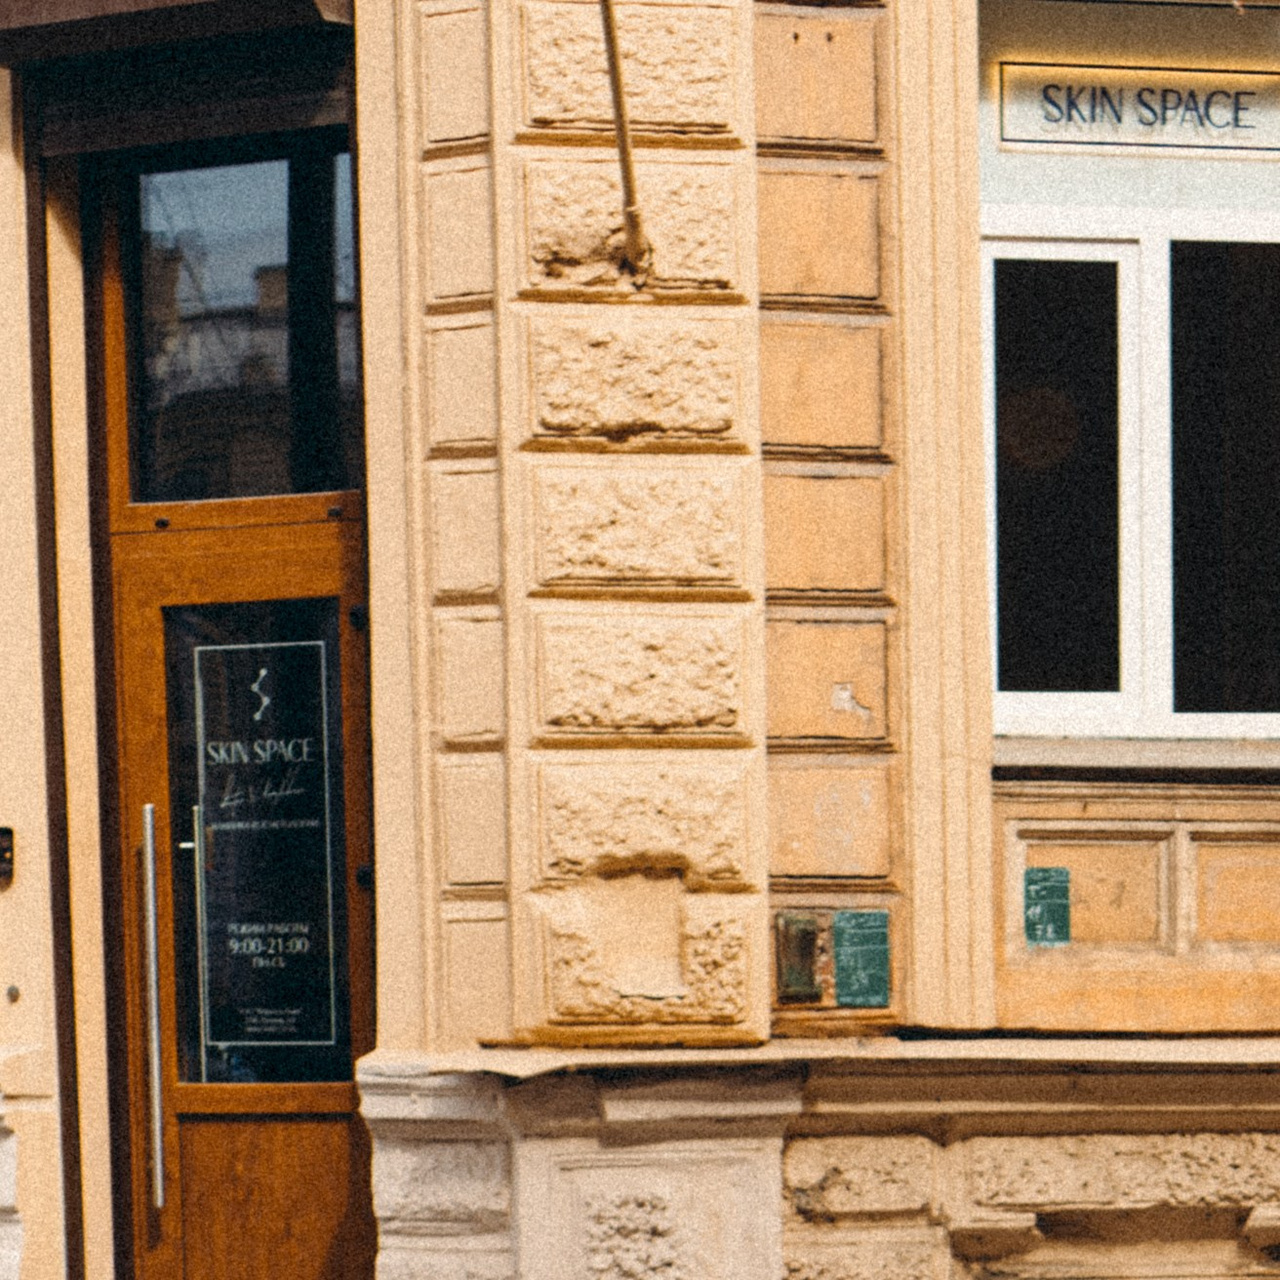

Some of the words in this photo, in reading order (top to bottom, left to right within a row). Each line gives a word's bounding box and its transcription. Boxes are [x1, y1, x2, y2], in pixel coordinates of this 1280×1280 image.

[1042, 84, 1124, 124] SKIN
[1135, 87, 1257, 129] SPACE
[206, 740, 249, 764] SKIN
[253, 738, 316, 764] SPACE
[229, 937, 310, 955] 9:00-21:00
